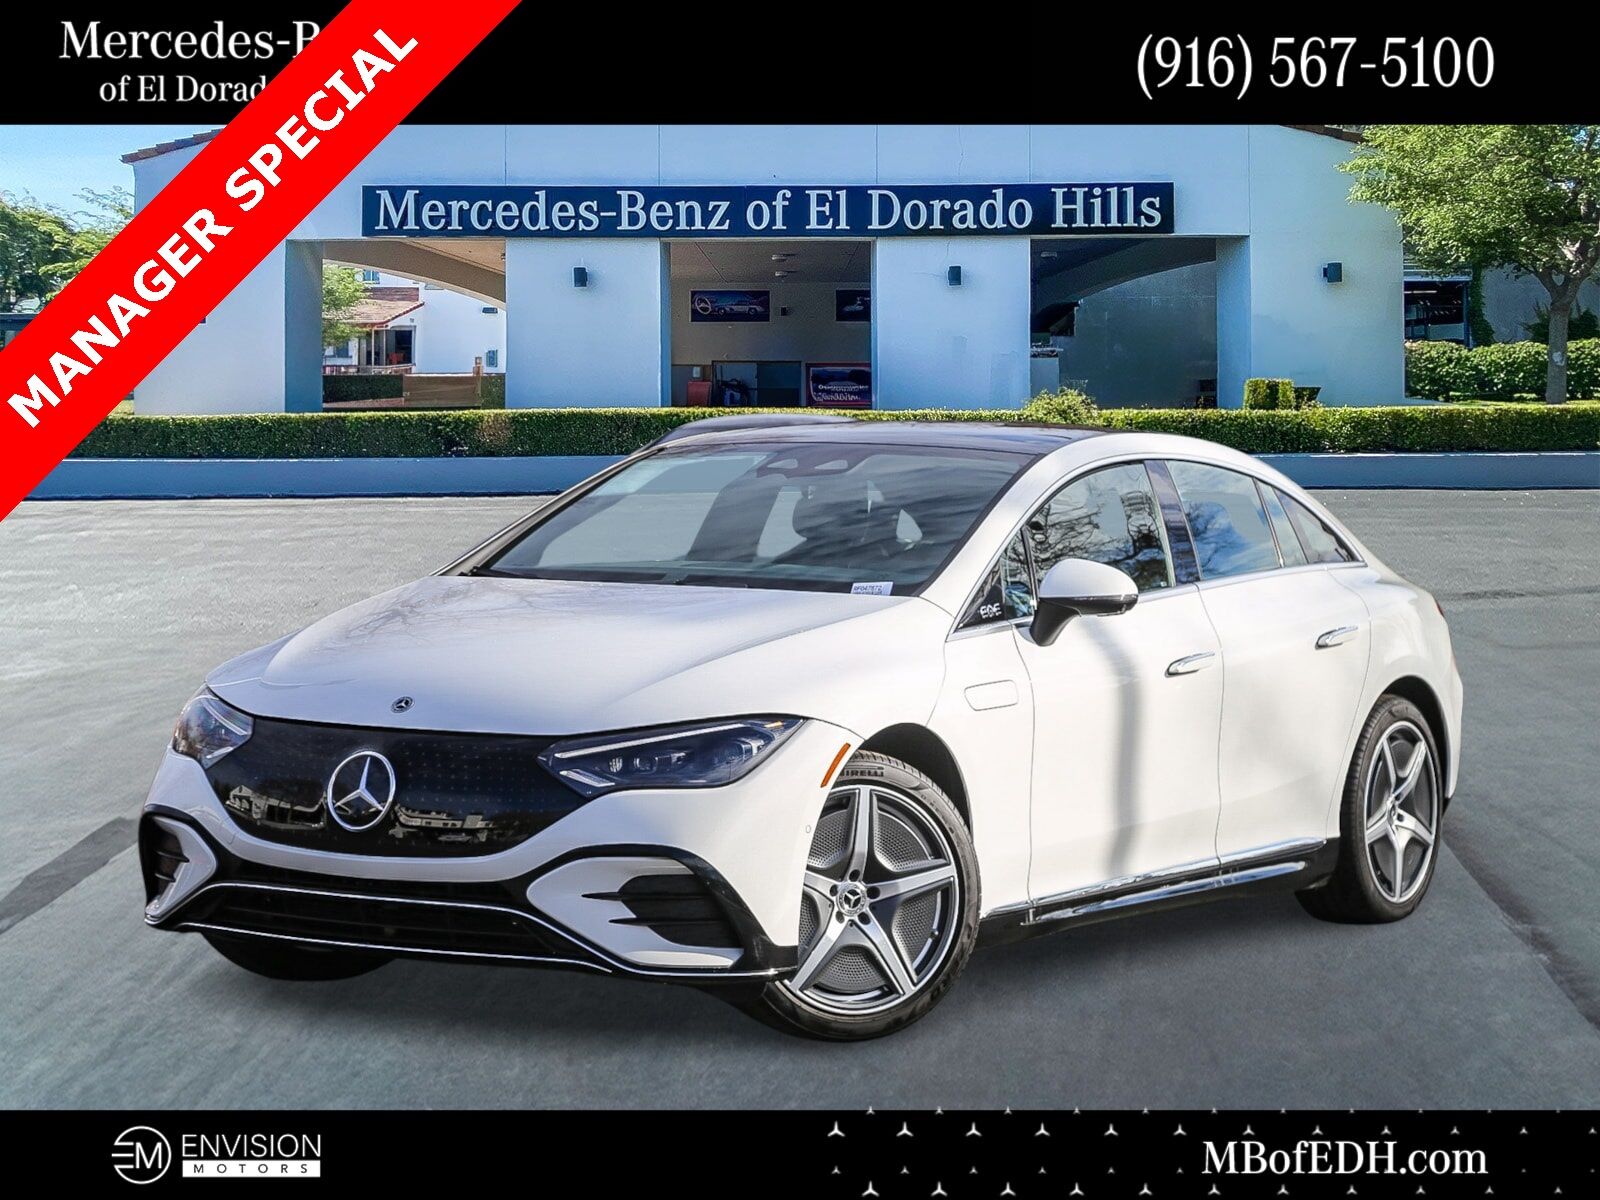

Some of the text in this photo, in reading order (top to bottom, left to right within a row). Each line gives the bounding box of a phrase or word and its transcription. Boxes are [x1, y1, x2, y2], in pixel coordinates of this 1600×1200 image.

[375, 186, 1162, 231] Mercedes-Benz of El Dorado Hills
